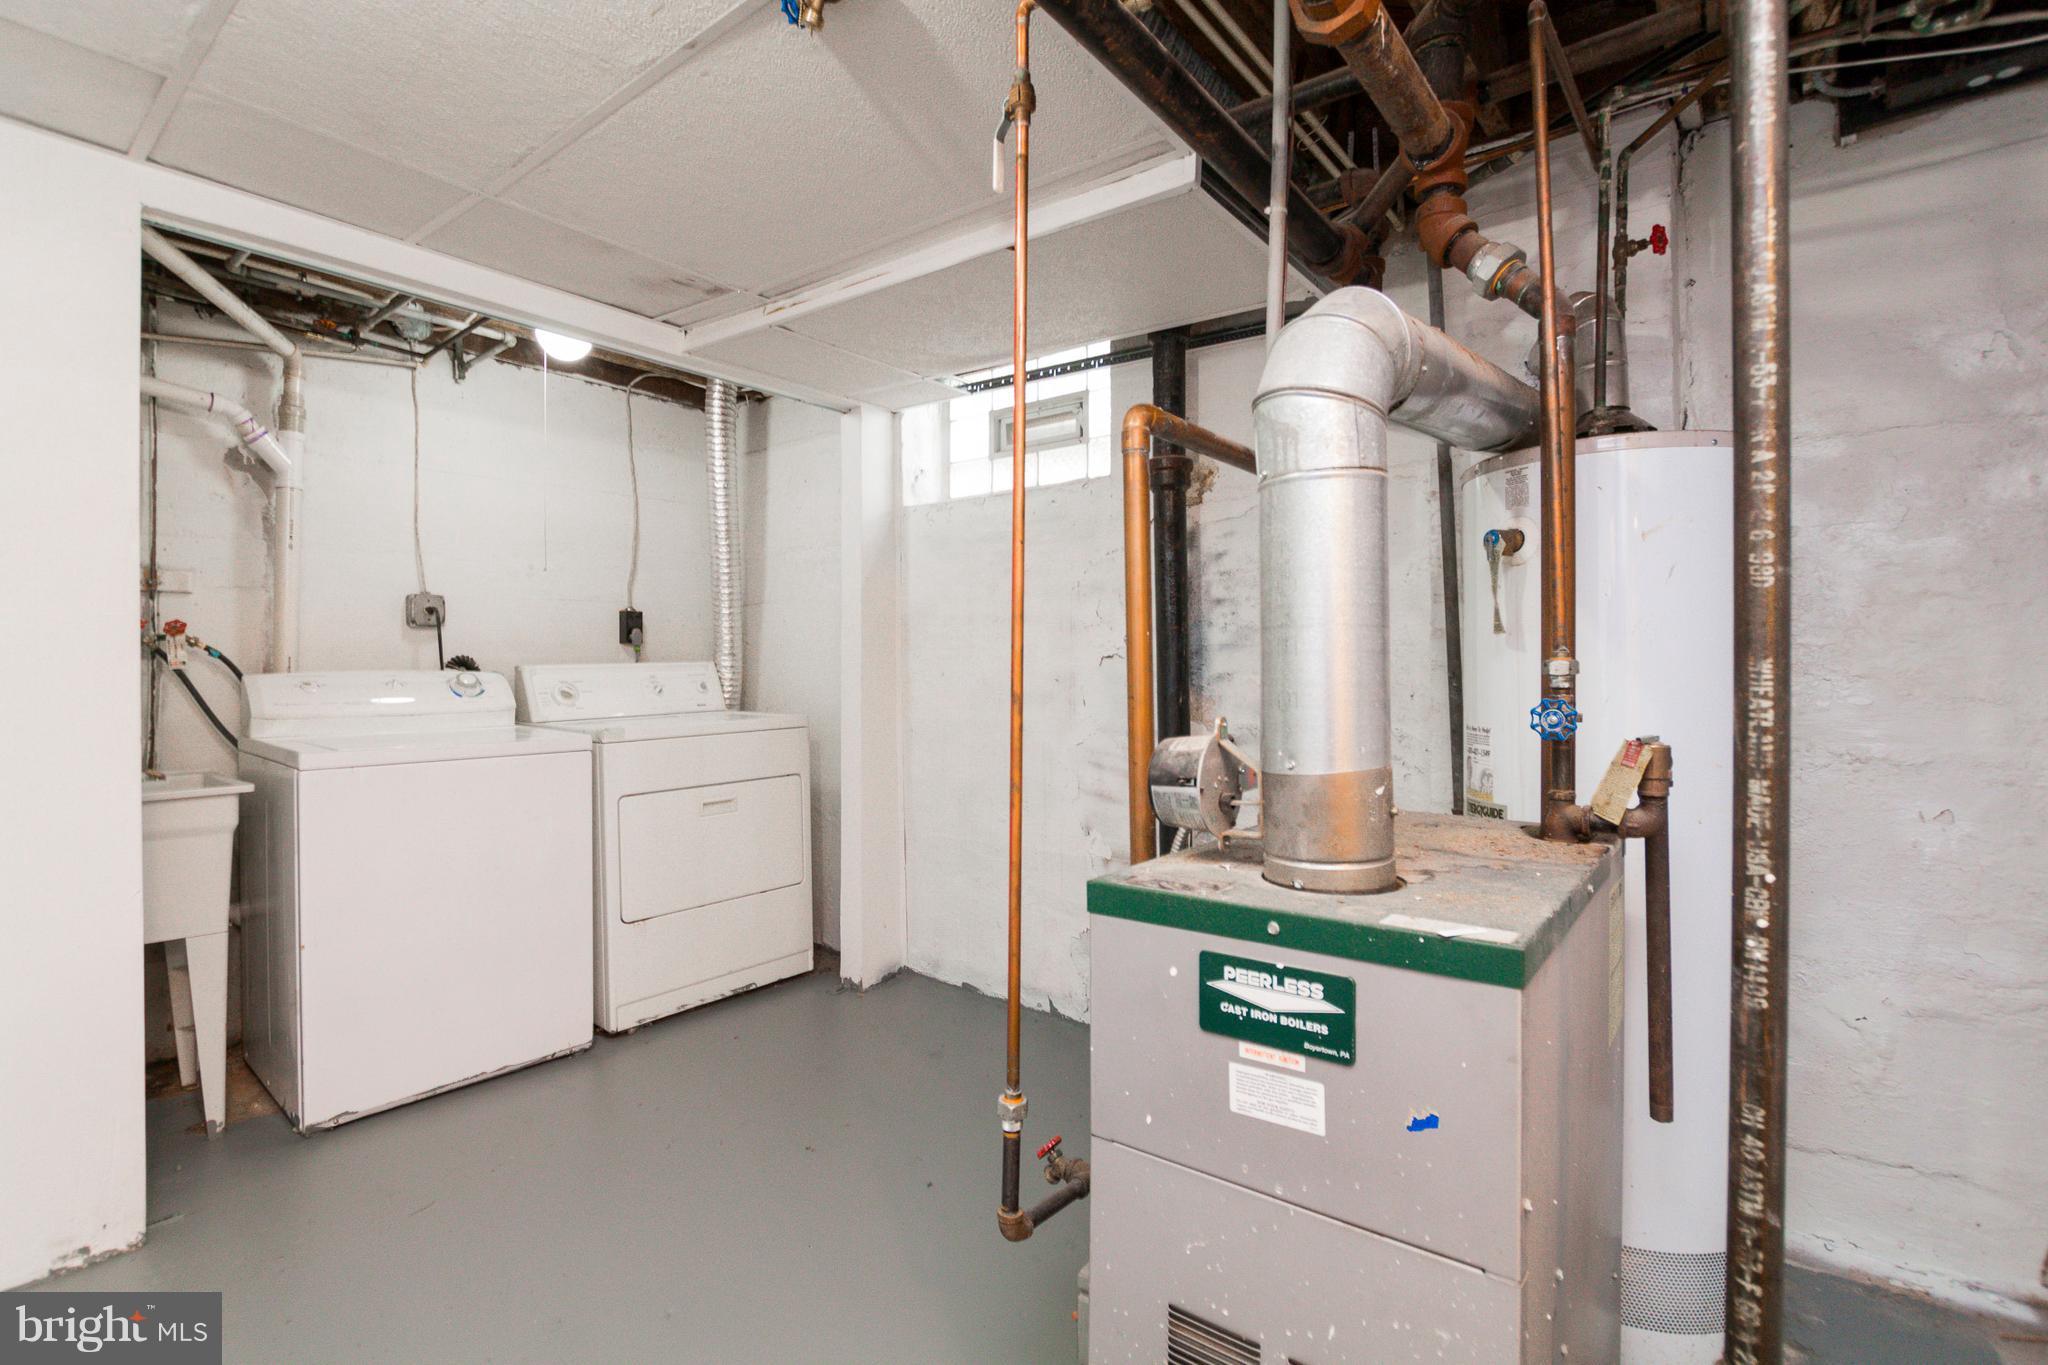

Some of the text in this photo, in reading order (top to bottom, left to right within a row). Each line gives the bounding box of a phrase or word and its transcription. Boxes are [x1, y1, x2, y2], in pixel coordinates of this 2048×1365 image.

[1223, 965, 1325, 1000] PEERLESS
[1220, 1001, 1329, 1035] CAST IRON BOILERS
[1340, 1050, 1350, 1060] PA
